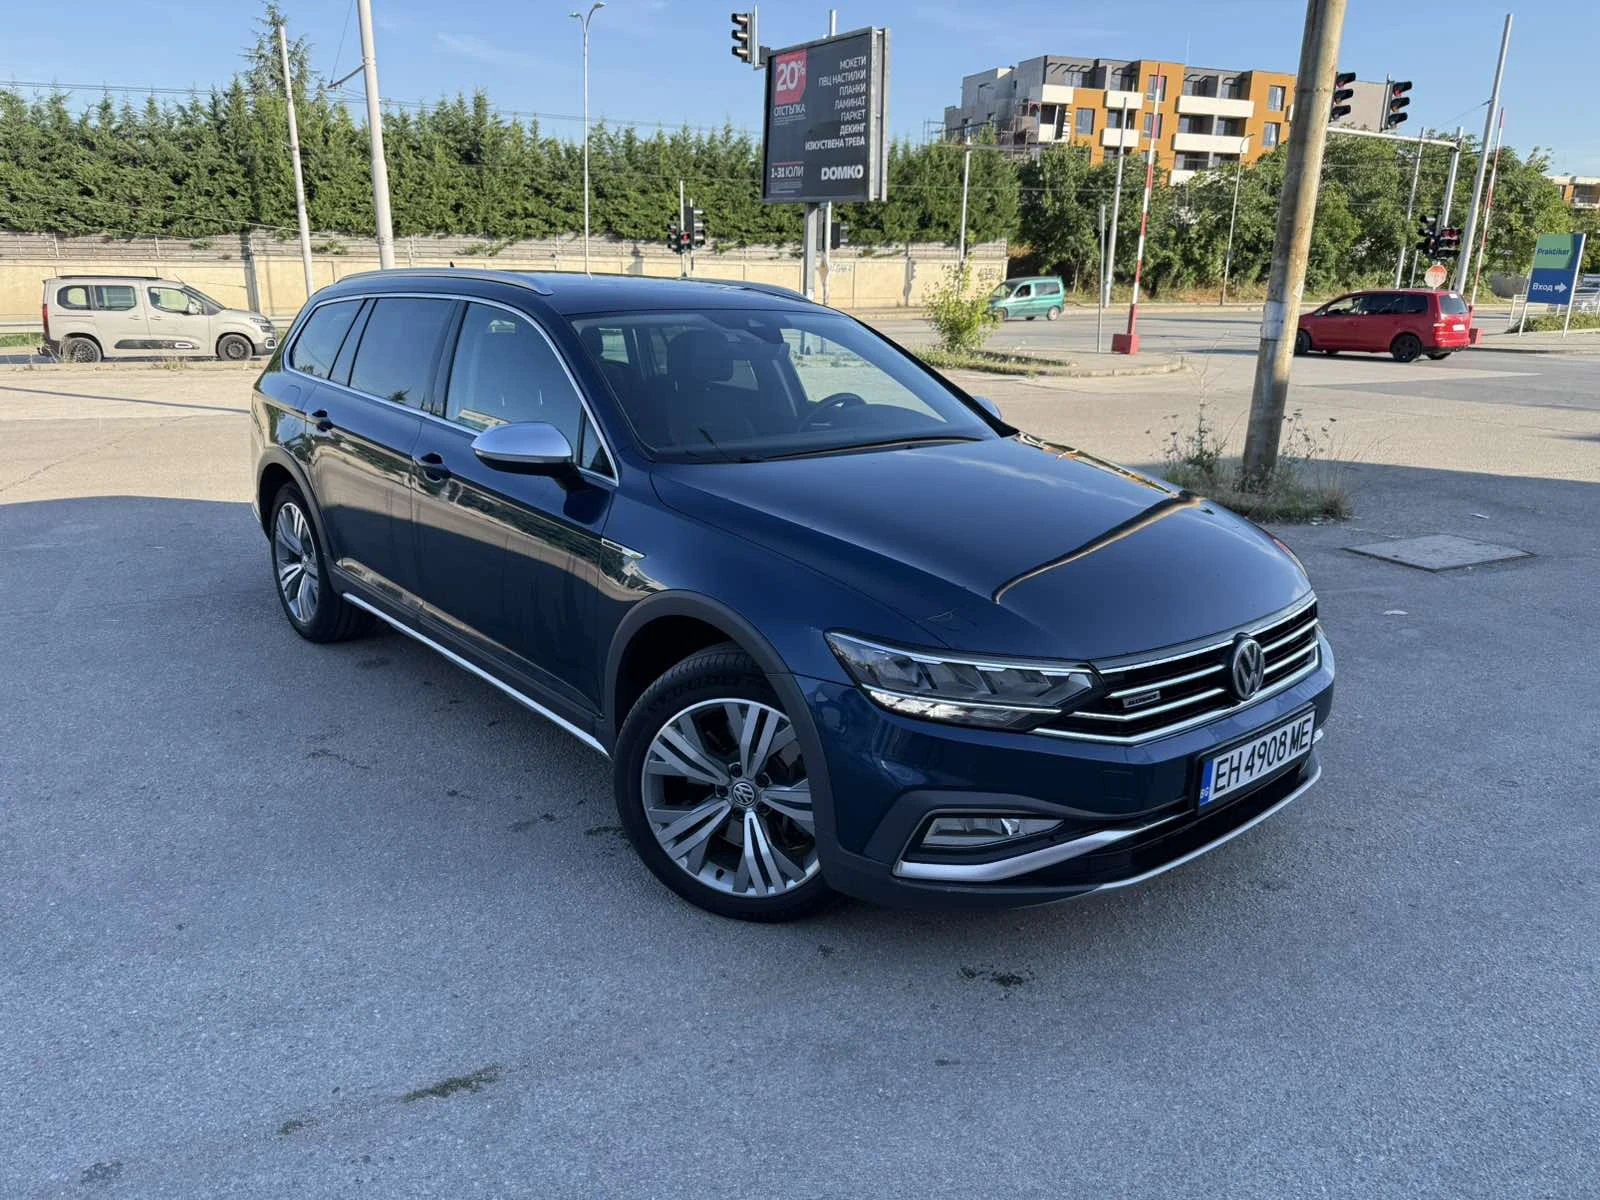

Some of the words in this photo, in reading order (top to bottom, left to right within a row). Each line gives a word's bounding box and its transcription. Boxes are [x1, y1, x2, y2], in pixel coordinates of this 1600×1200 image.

[840, 56, 867, 69] МОКЕТИ
[776, 60, 806, 92] 20%
[832, 69, 866, 84] НАСТИЛКИ
[840, 83, 866, 95] ПЛАНКИ
[834, 95, 866, 110] ЛАМИНАТ
[841, 109, 866, 121] ПАРКЕТ
[840, 122, 866, 136] ДЕКИНГ
[845, 135, 866, 148] ТРЕВА
[821, 164, 864, 180] DOMKO
[1536, 247, 1570, 256] Praktiker
[1532, 282, 1554, 292] Вход
[1214, 750, 1242, 793] EH
[1244, 730, 1288, 777] 4908
[1288, 717, 1312, 757] ME
